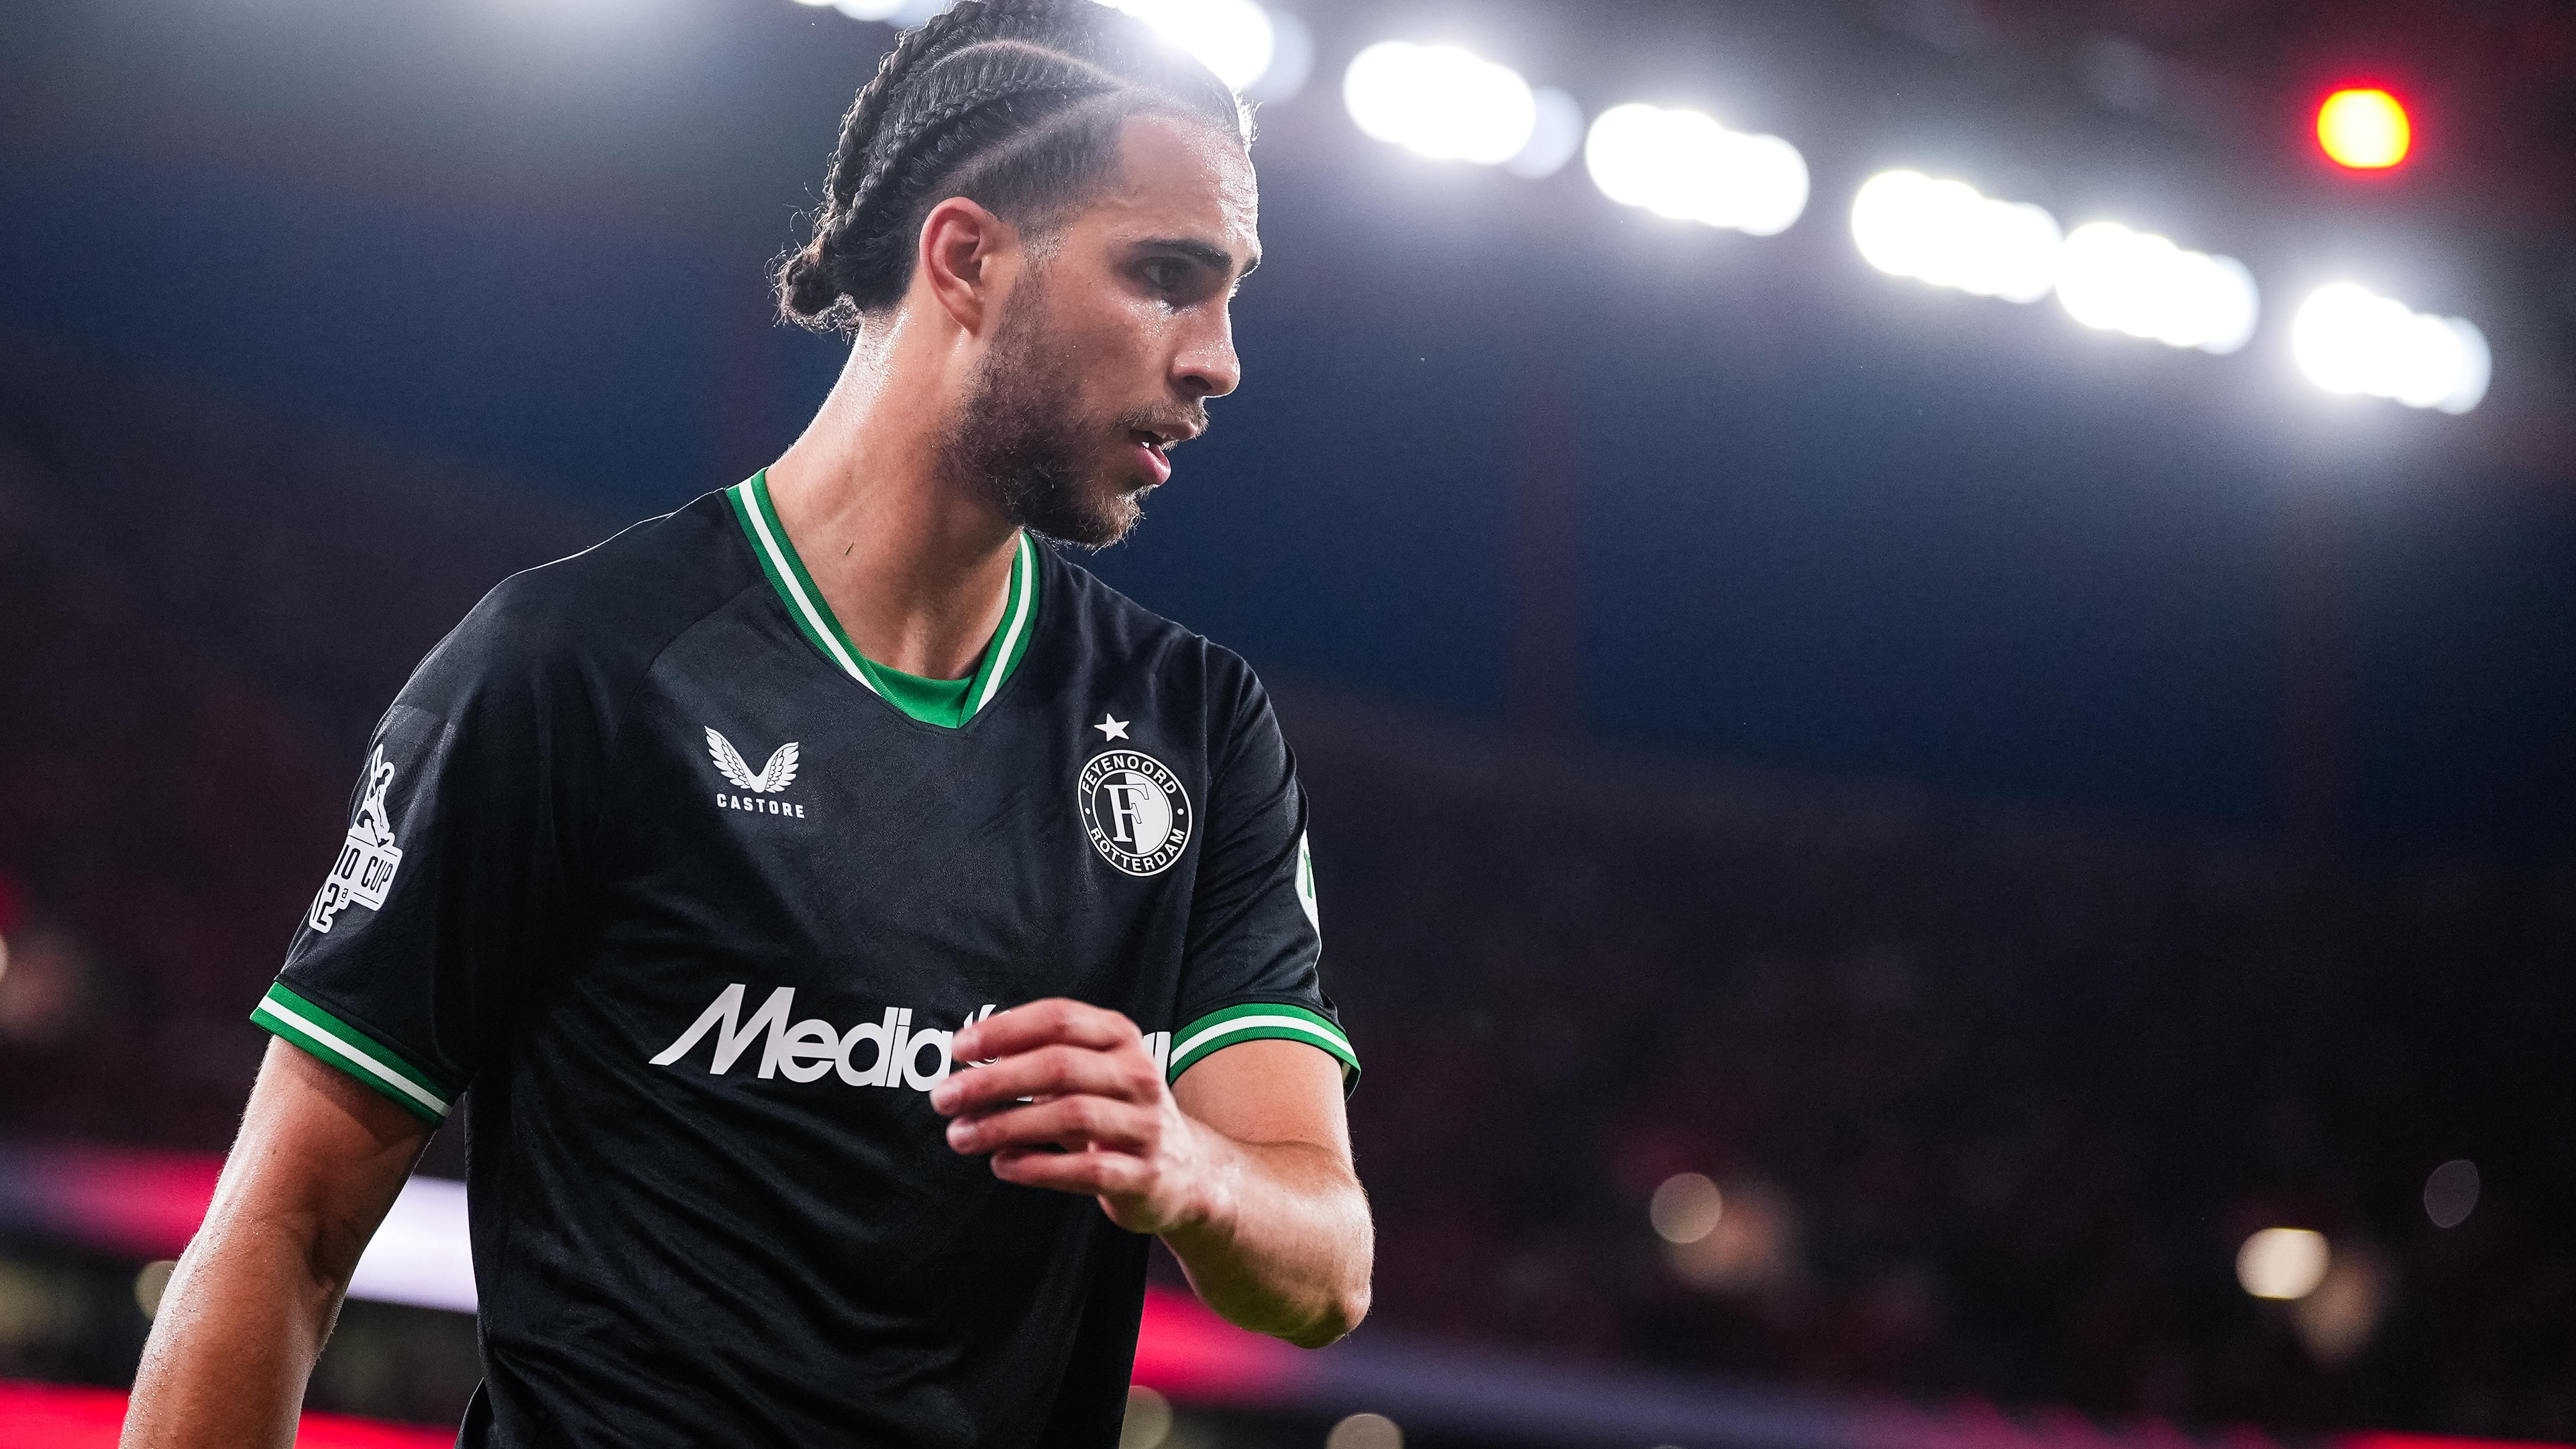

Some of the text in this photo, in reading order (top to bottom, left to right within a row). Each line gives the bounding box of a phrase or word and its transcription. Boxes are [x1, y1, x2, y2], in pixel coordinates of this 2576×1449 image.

[1081, 755, 1177, 795] FEYENOORD
[716, 793, 805, 818] CASTORE
[1104, 783, 1149, 843] F
[1090, 828, 1185, 871] ROTTERDAM
[361, 855, 393, 894] CUP
